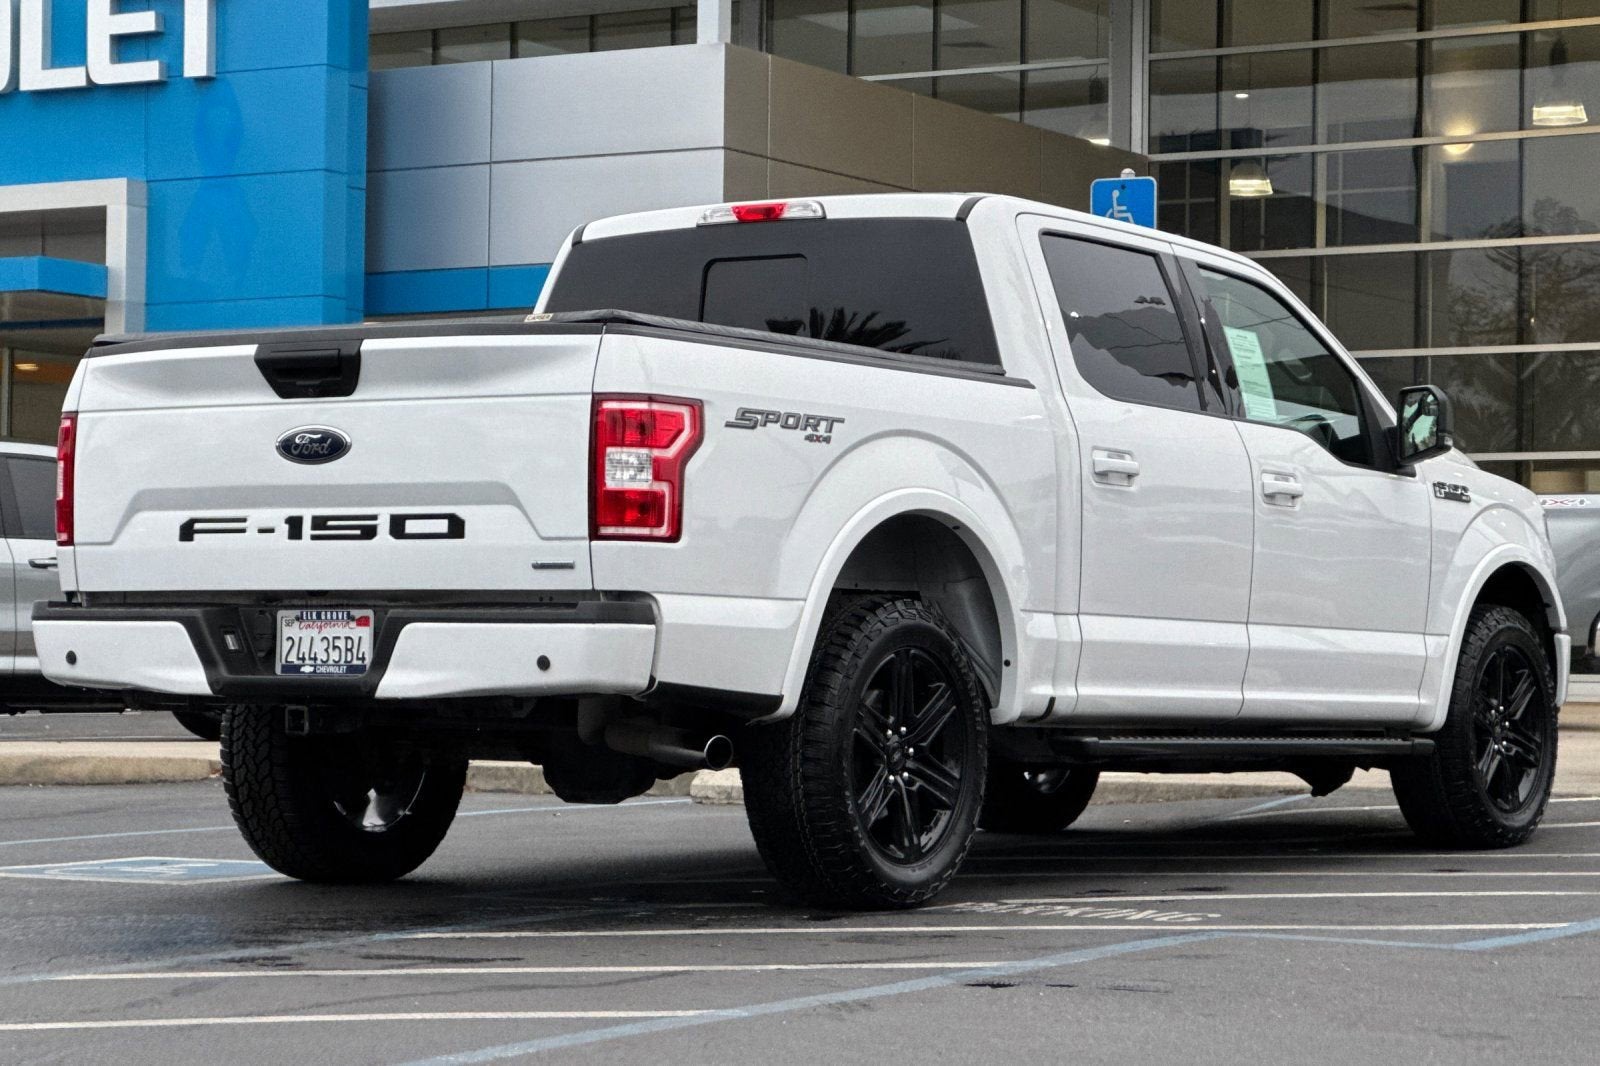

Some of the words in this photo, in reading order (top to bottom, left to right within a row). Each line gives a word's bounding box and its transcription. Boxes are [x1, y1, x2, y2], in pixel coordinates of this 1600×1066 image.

[724, 407, 845, 433] SPORT
[291, 433, 332, 455] Ford
[179, 513, 465, 541] F-150
[303, 611, 317, 620] ELK
[320, 611, 348, 620] GROVE
[285, 636, 366, 664] 24435B4
[315, 665, 347, 673] CHEVROLET
